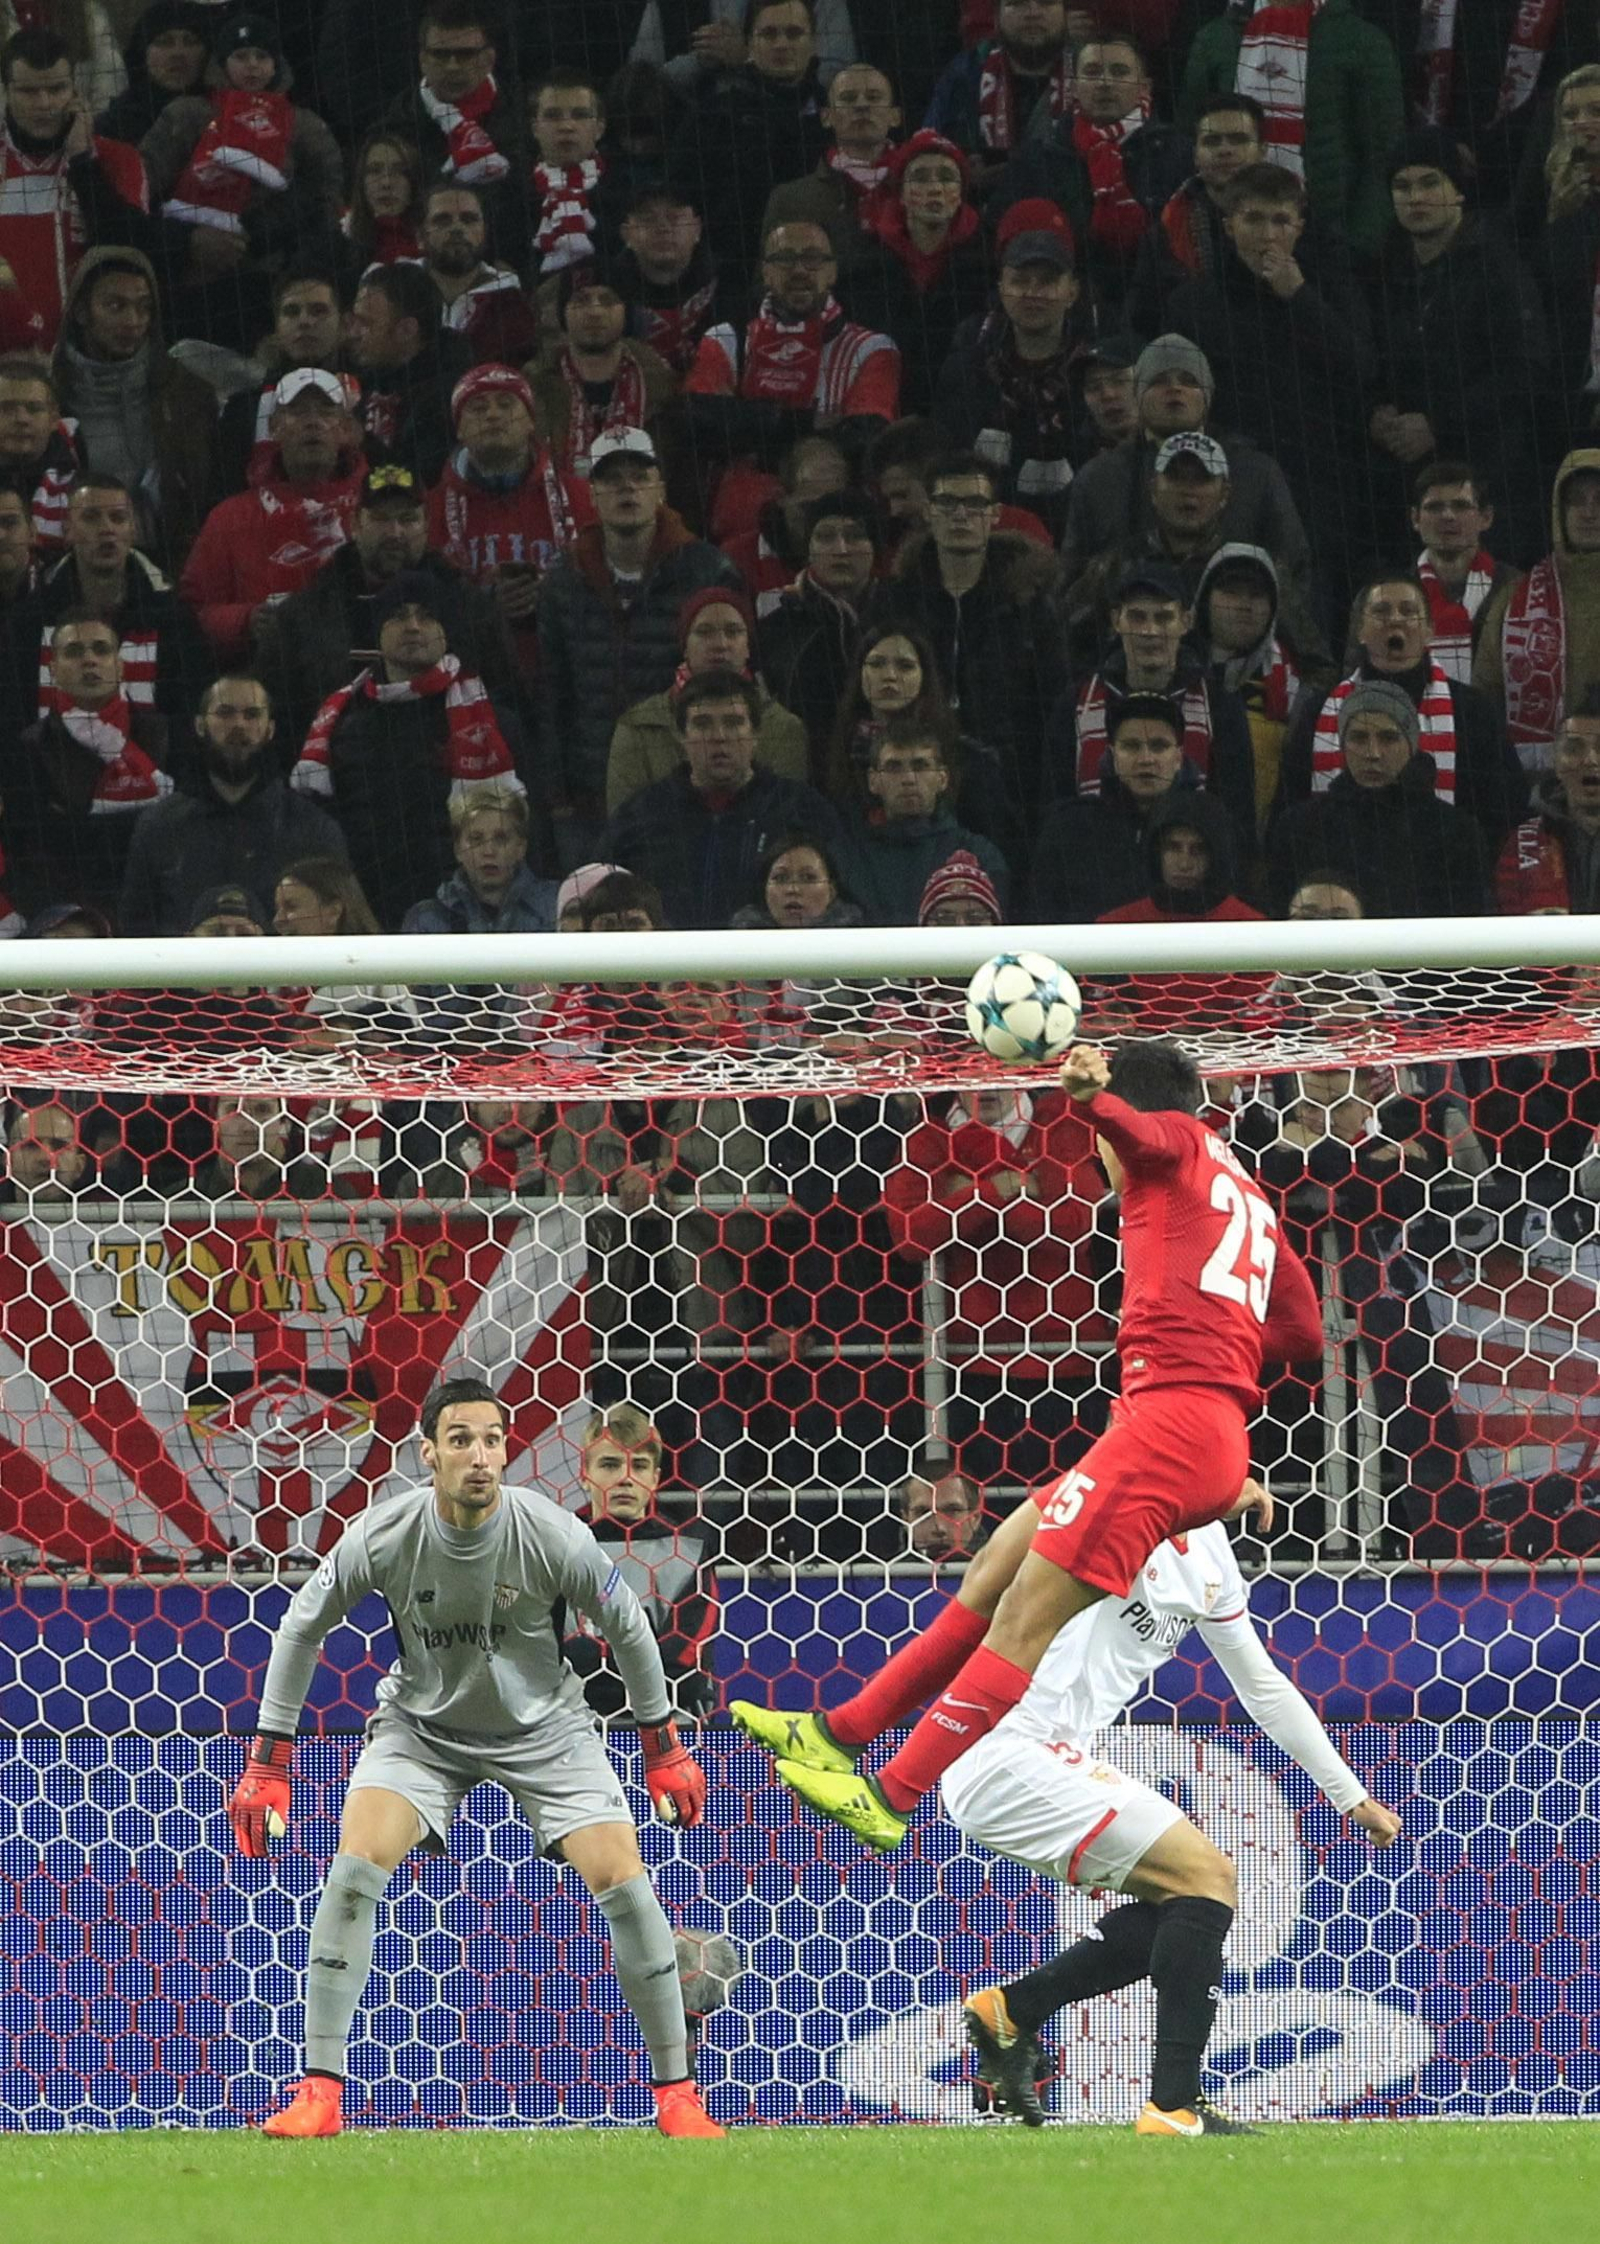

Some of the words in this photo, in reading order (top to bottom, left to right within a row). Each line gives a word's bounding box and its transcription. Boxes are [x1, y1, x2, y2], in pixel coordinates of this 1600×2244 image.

[89, 1239, 458, 1317] ТОМСК
[1199, 1172, 1278, 1324] 25
[931, 1710, 970, 1736] FCSM
